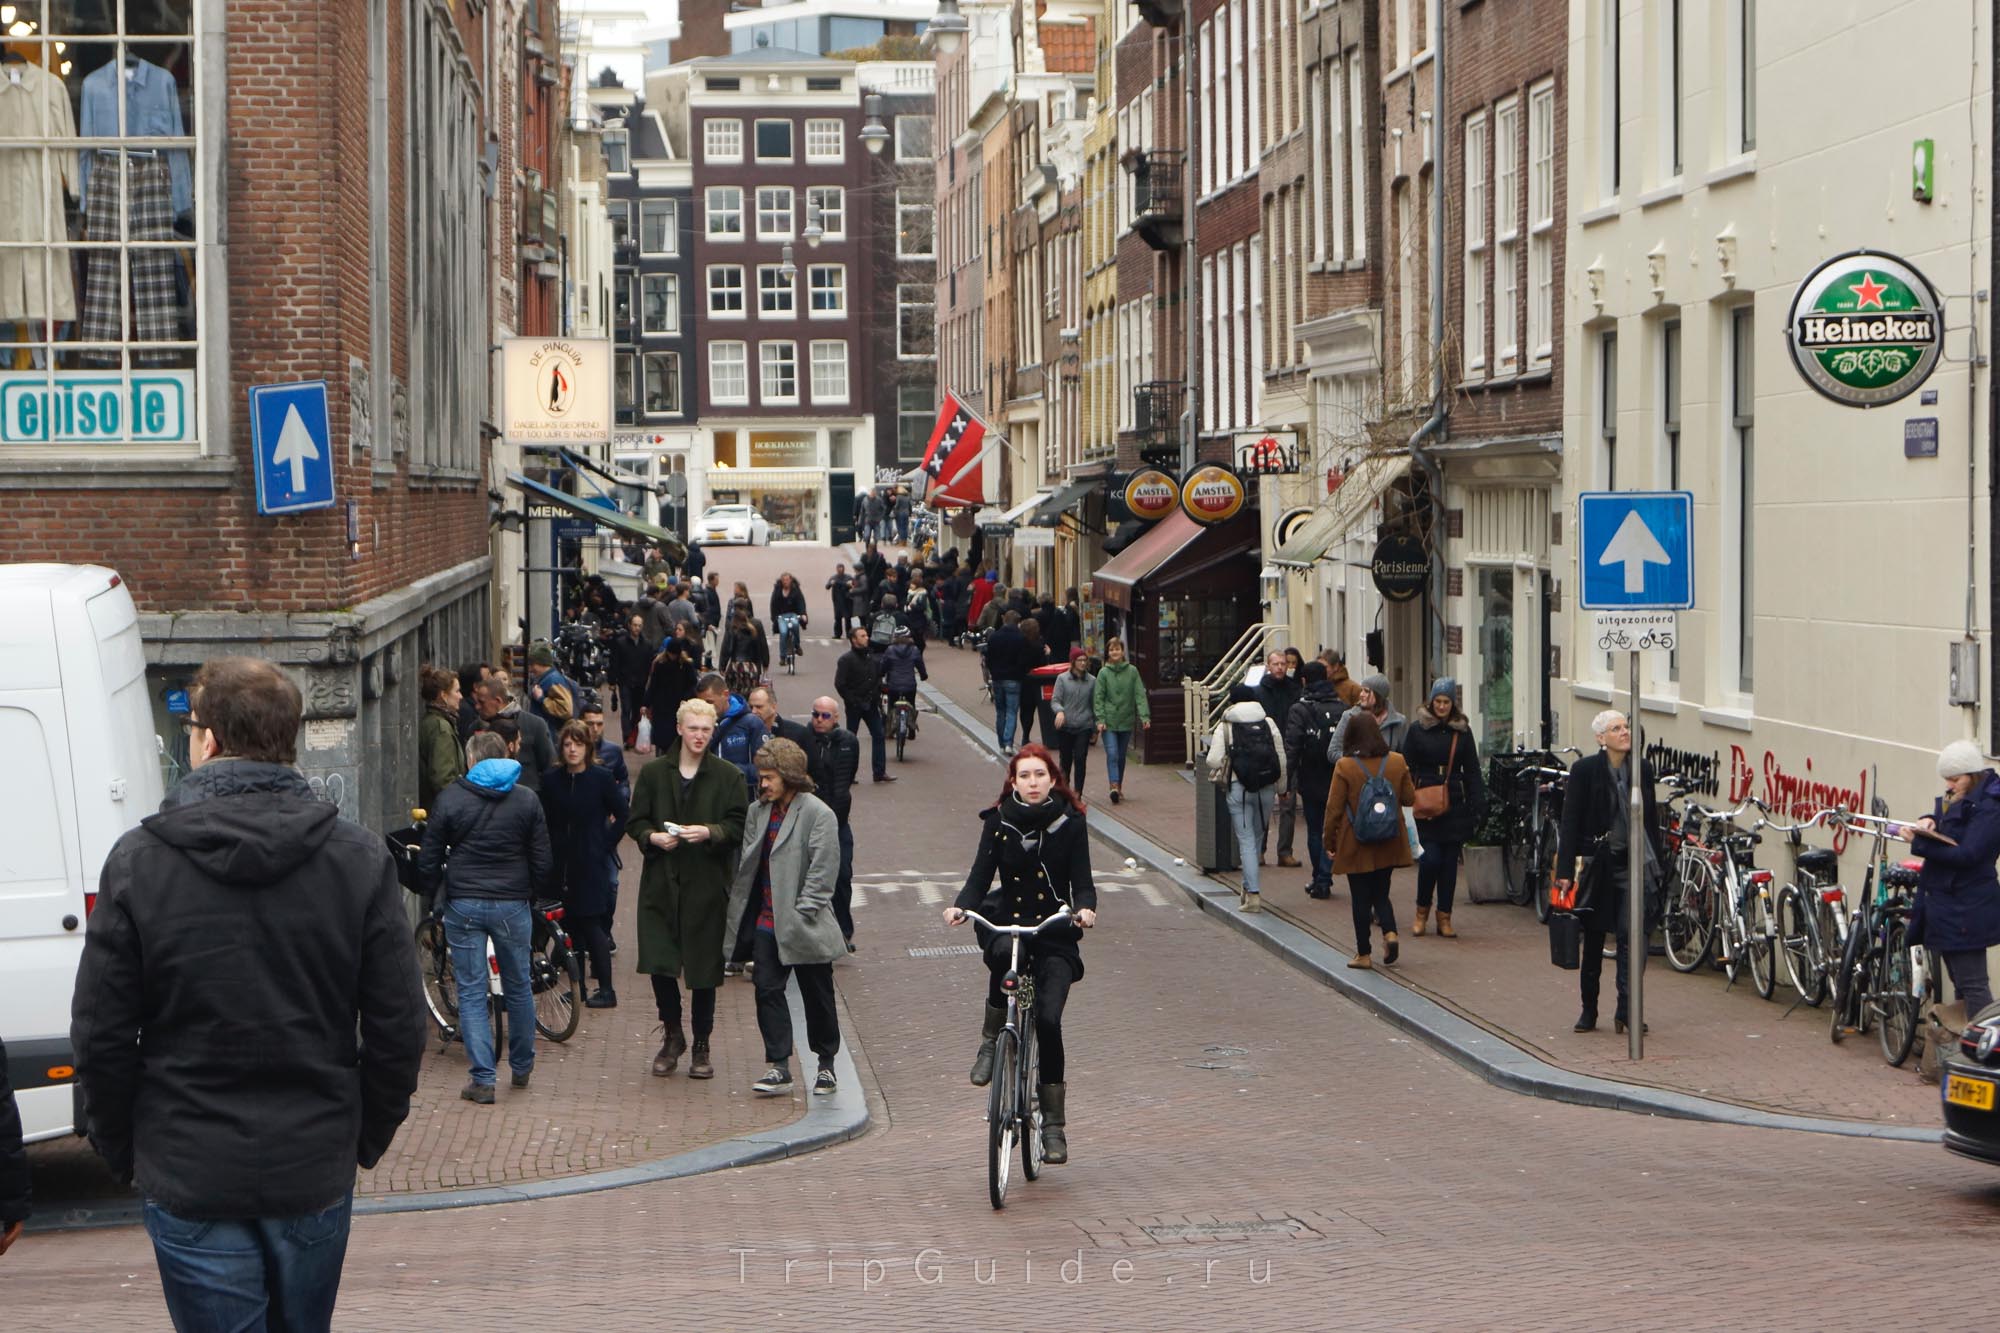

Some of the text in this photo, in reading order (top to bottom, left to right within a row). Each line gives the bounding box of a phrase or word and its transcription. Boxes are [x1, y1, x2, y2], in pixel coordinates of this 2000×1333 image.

[1804, 316, 1931, 343] Heineken
[529, 350, 543, 367] DE
[509, 431, 523, 439] TOT
[1136, 487, 1171, 496] AMSTEL
[1195, 486, 1232, 496] AMSTEL
[1203, 497, 1225, 505] BIER
[1374, 559, 1430, 575] Parisienne
[1597, 615, 1673, 626] uitgezonderd
[1728, 744, 1754, 804] De
